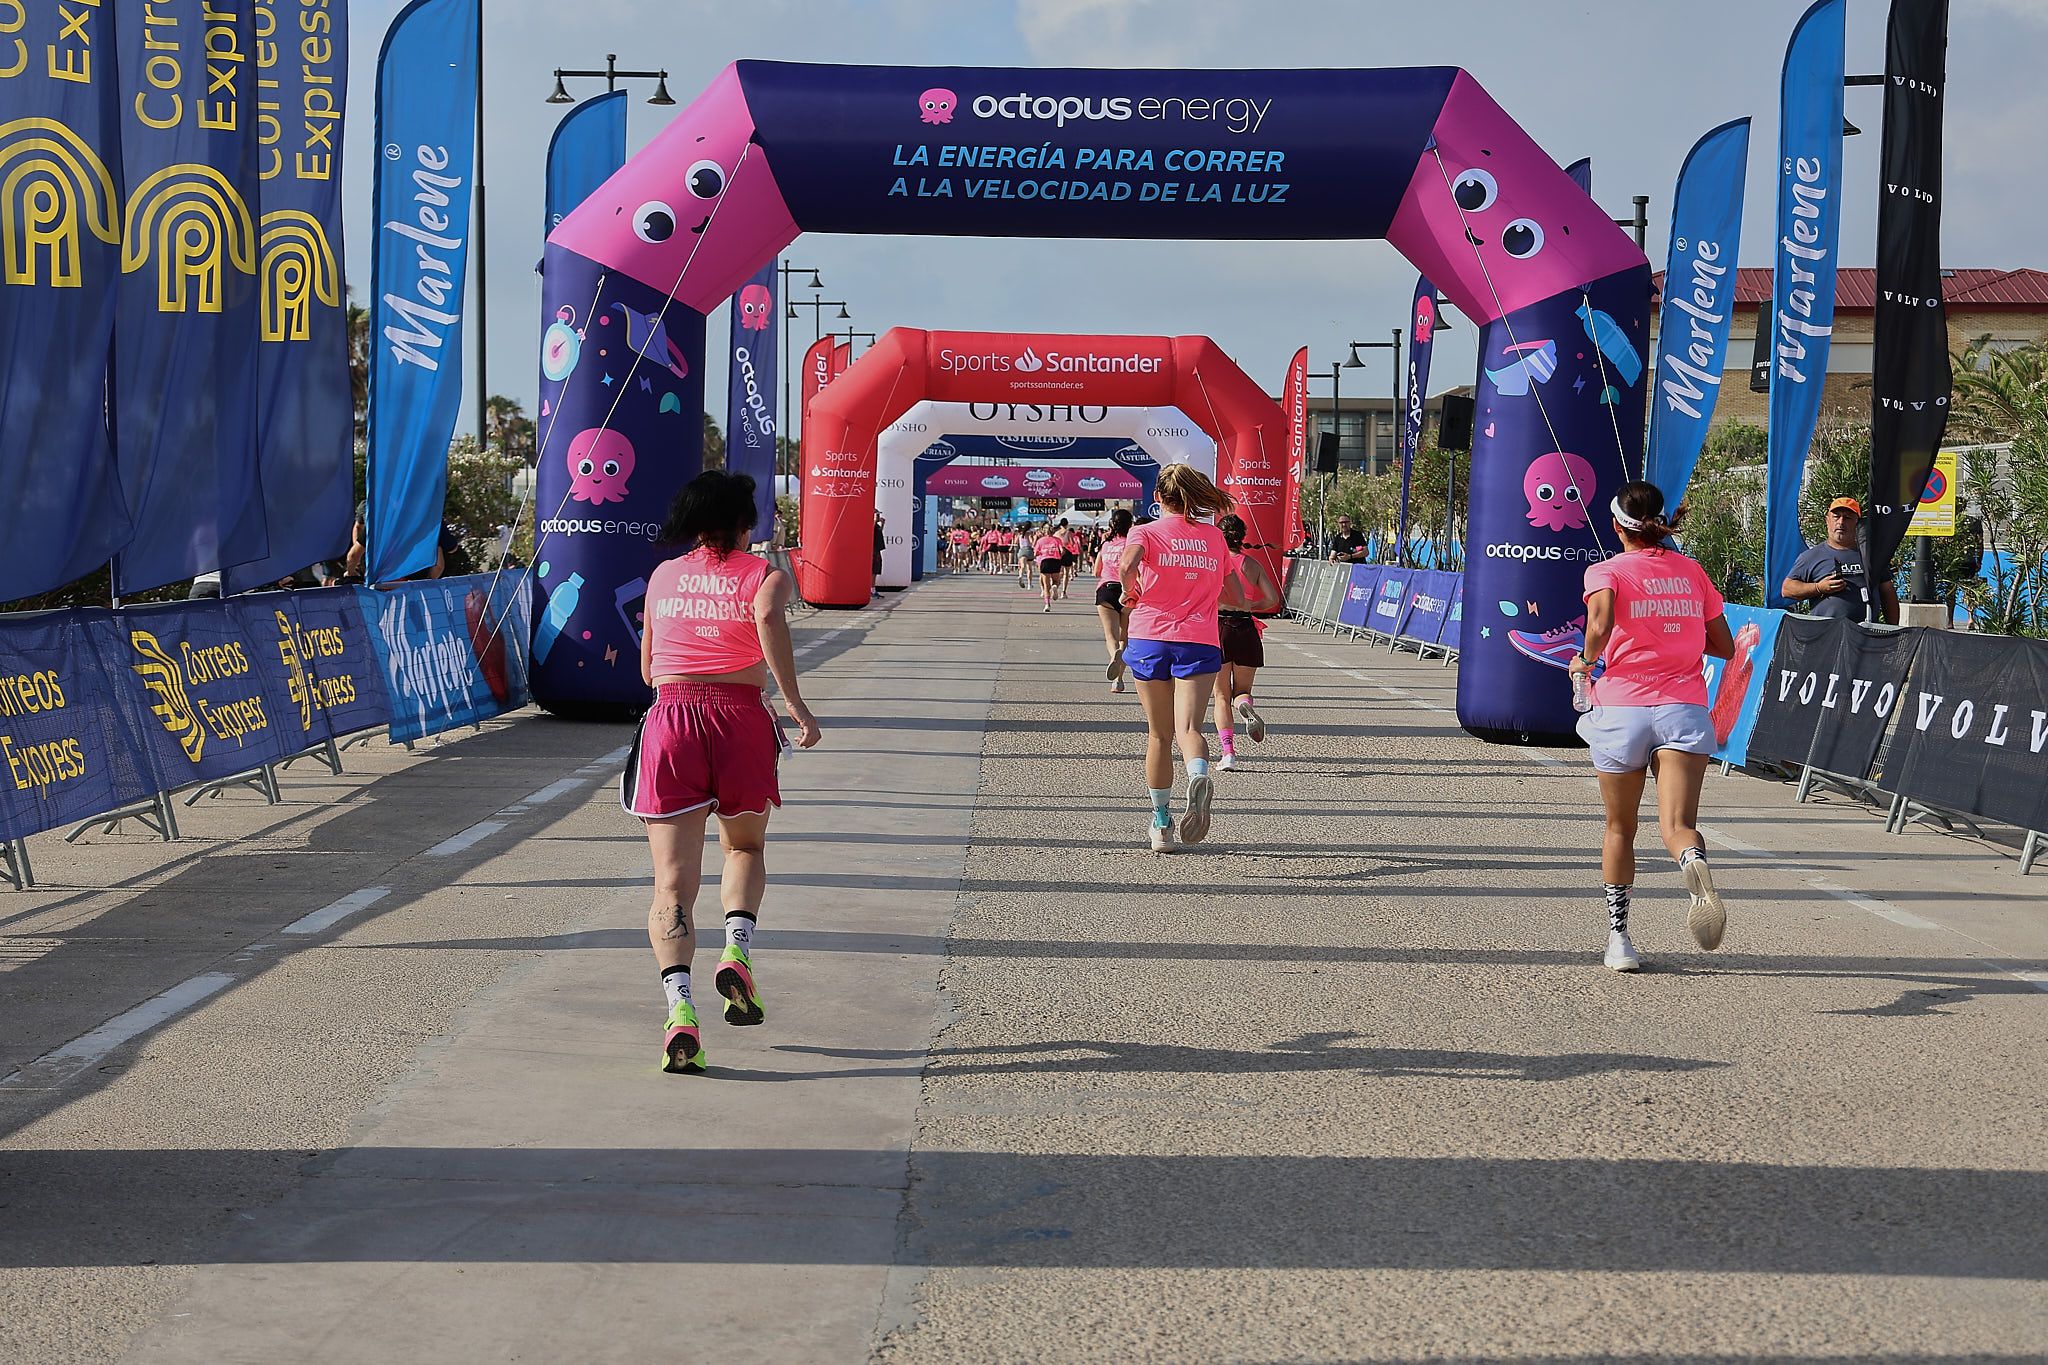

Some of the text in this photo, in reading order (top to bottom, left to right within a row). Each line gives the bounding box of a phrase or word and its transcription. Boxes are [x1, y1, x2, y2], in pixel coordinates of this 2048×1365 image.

[972, 92, 1273, 134] octopus energy
[892, 141, 1286, 173] LA ENERGÍA PARA CORRER
[888, 177, 1290, 203] A LA VELOCIDAD DE LA LUZ
[1886, 183, 1933, 204] VOLVO
[383, 144, 463, 371] Marlene
[1777, 156, 1833, 384] Marlene
[1883, 290, 1938, 308] VOLVO
[1662, 239, 1728, 419] Marlene
[940, 349, 1162, 376] Sports Santander
[735, 346, 776, 436] octopus
[1009, 380, 1084, 390] sportssantander.es
[1881, 395, 1948, 412] VOLVO
[740, 406, 761, 449] energy
[1146, 427, 1190, 437] OYSHO
[825, 450, 858, 467] Sports
[1289, 361, 1304, 545] Sports Santander
[821, 467, 871, 479] Santander
[1238, 457, 1272, 475] Sports
[1235, 474, 1282, 488] Santander
[540, 519, 602, 537] octopus
[1171, 538, 1208, 553] SOMOS
[1486, 542, 1562, 563] octopus
[1158, 553, 1218, 572] IMPARABLES
[676, 573, 739, 595] SOMOS
[1641, 576, 1692, 596] SOMOS
[695, 625, 721, 638] 2026
[1663, 622, 1682, 634] 2026
[180, 640, 250, 687] Correos
[1778, 668, 1895, 720] VOLVO
[197, 694, 269, 749] Express
[0, 734, 86, 801] Express
